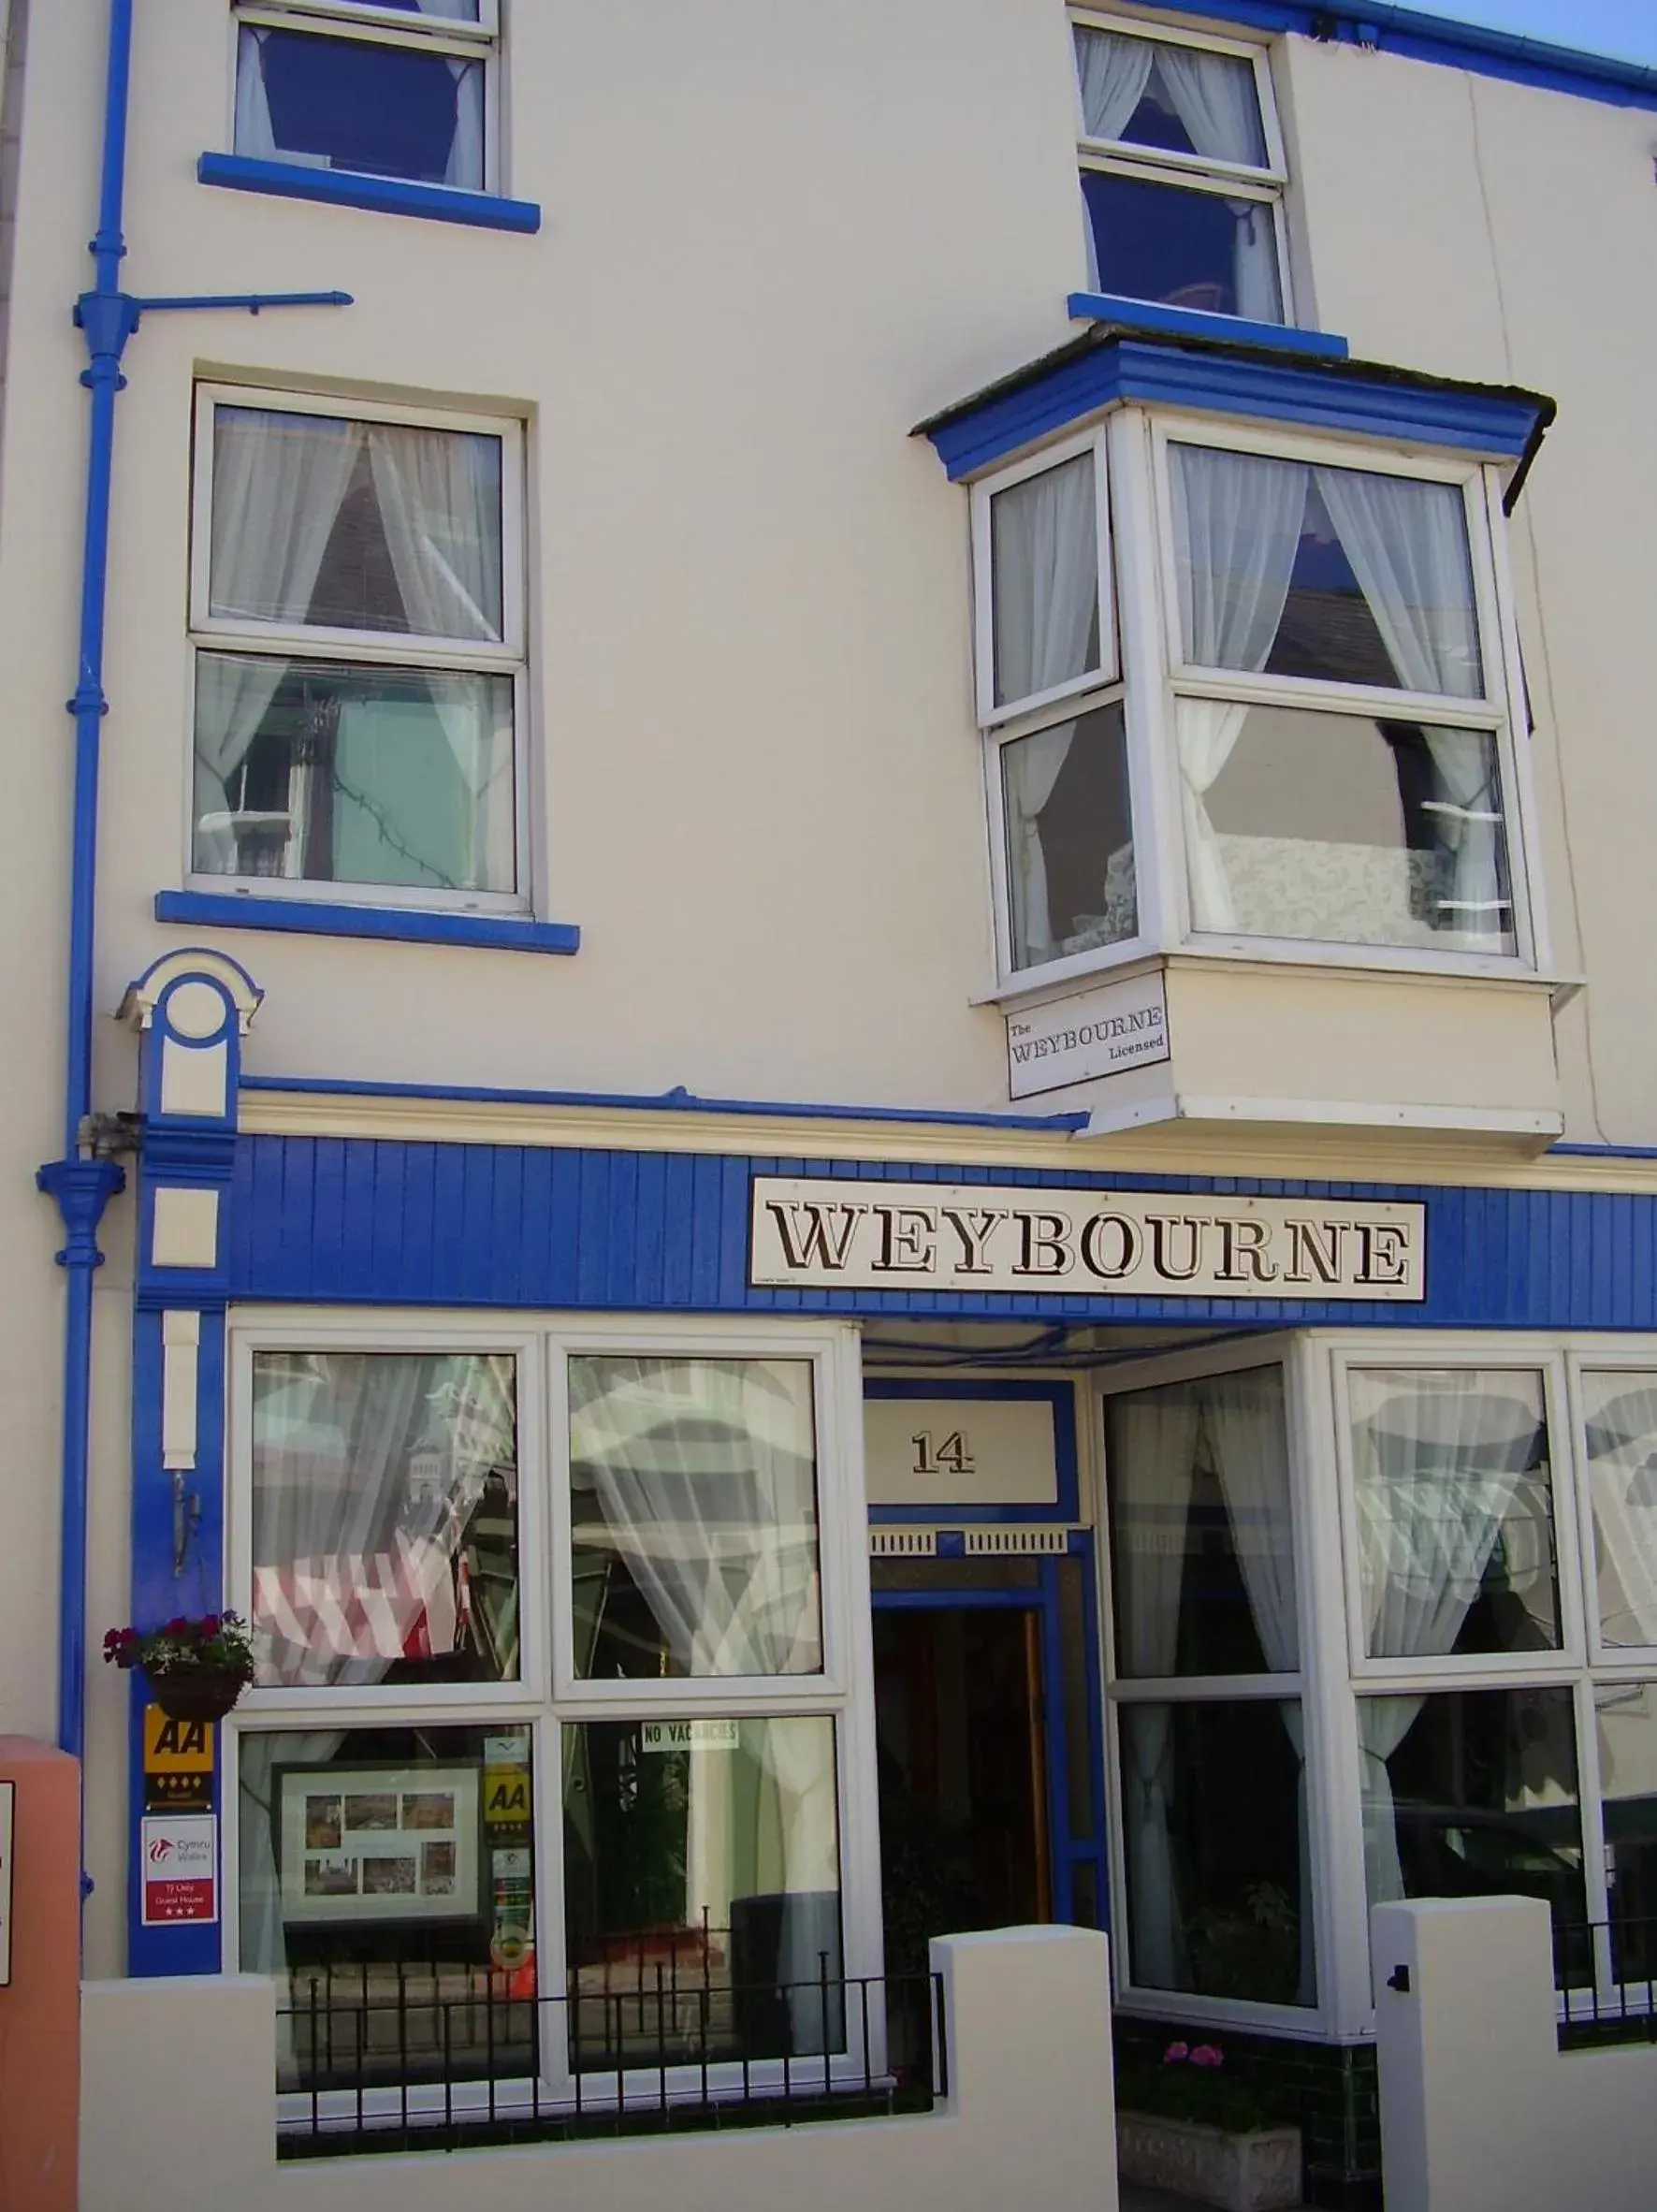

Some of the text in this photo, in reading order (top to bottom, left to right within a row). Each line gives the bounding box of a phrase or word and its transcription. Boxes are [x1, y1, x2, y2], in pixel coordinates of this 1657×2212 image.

[1010, 1024, 1031, 1037] The
[1011, 1006, 1163, 1064] WEYBOURNE
[1109, 1034, 1164, 1059] Licensed
[764, 1200, 1411, 1286] WEYBOURNE
[911, 1430, 975, 1474] 14
[153, 1721, 205, 1754] AA
[645, 1725, 661, 1743] NO
[488, 1783, 527, 1811] AA
